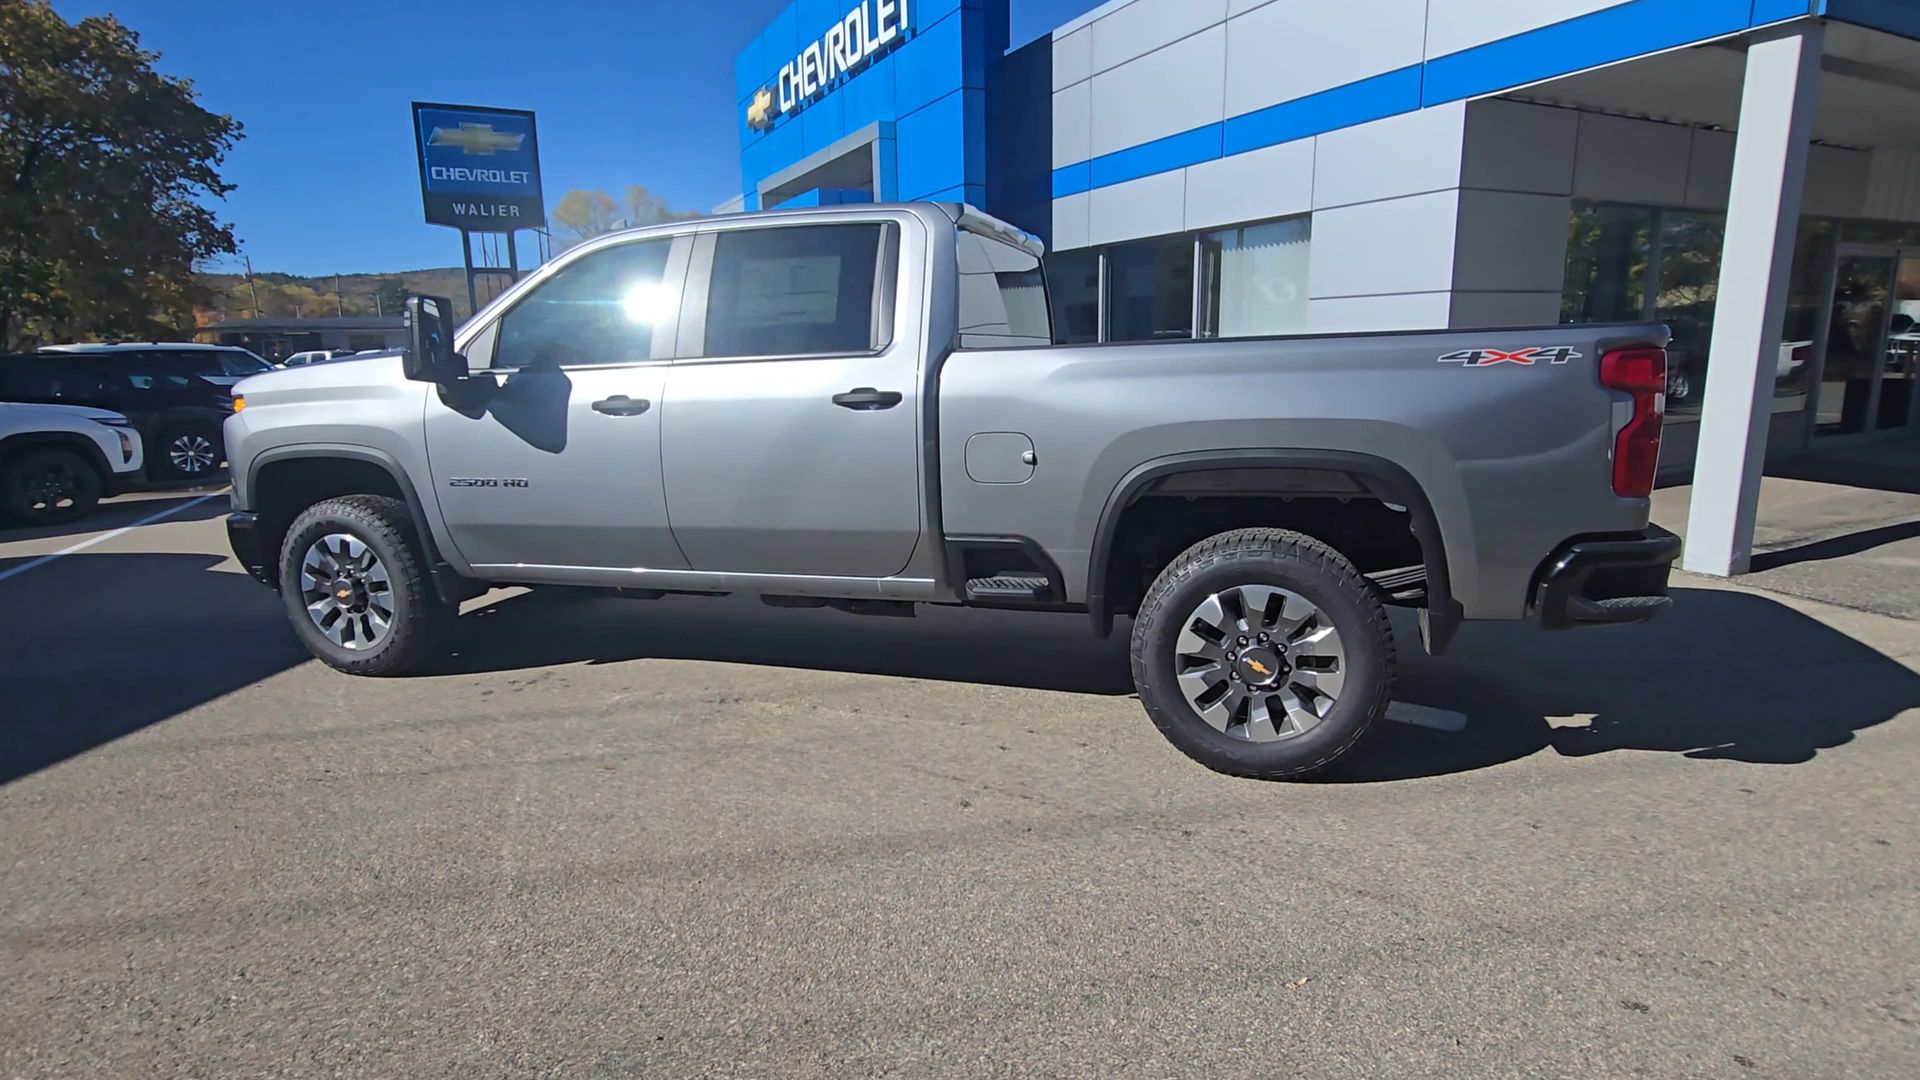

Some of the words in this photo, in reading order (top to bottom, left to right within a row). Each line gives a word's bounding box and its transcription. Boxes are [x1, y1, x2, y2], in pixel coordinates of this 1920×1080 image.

[431, 166, 529, 184] CHEVROLET
[452, 203, 520, 217] WALIER
[449, 478, 498, 488] 2500
[503, 478, 528, 488] HD
